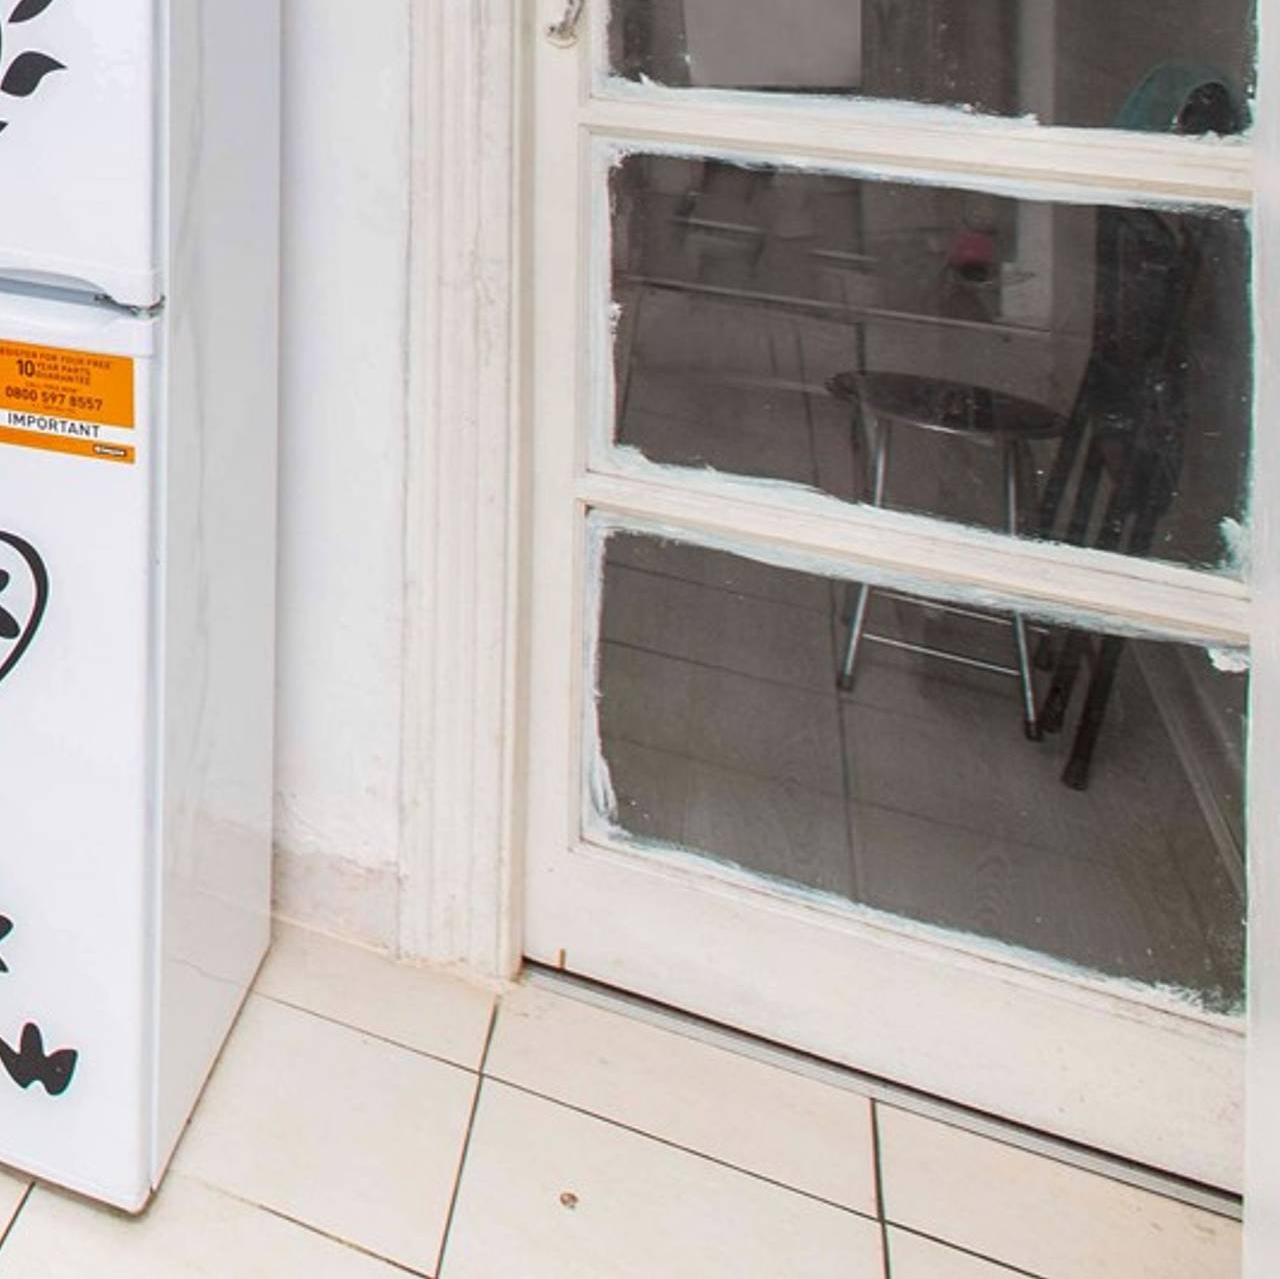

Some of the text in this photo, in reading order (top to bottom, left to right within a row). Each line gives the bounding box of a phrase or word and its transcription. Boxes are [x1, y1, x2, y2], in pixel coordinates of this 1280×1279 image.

[16, 358, 36, 378] 10
[5, 385, 38, 402] 0800
[41, 391, 67, 405] 597
[7, 412, 101, 438] IMPORTANT
